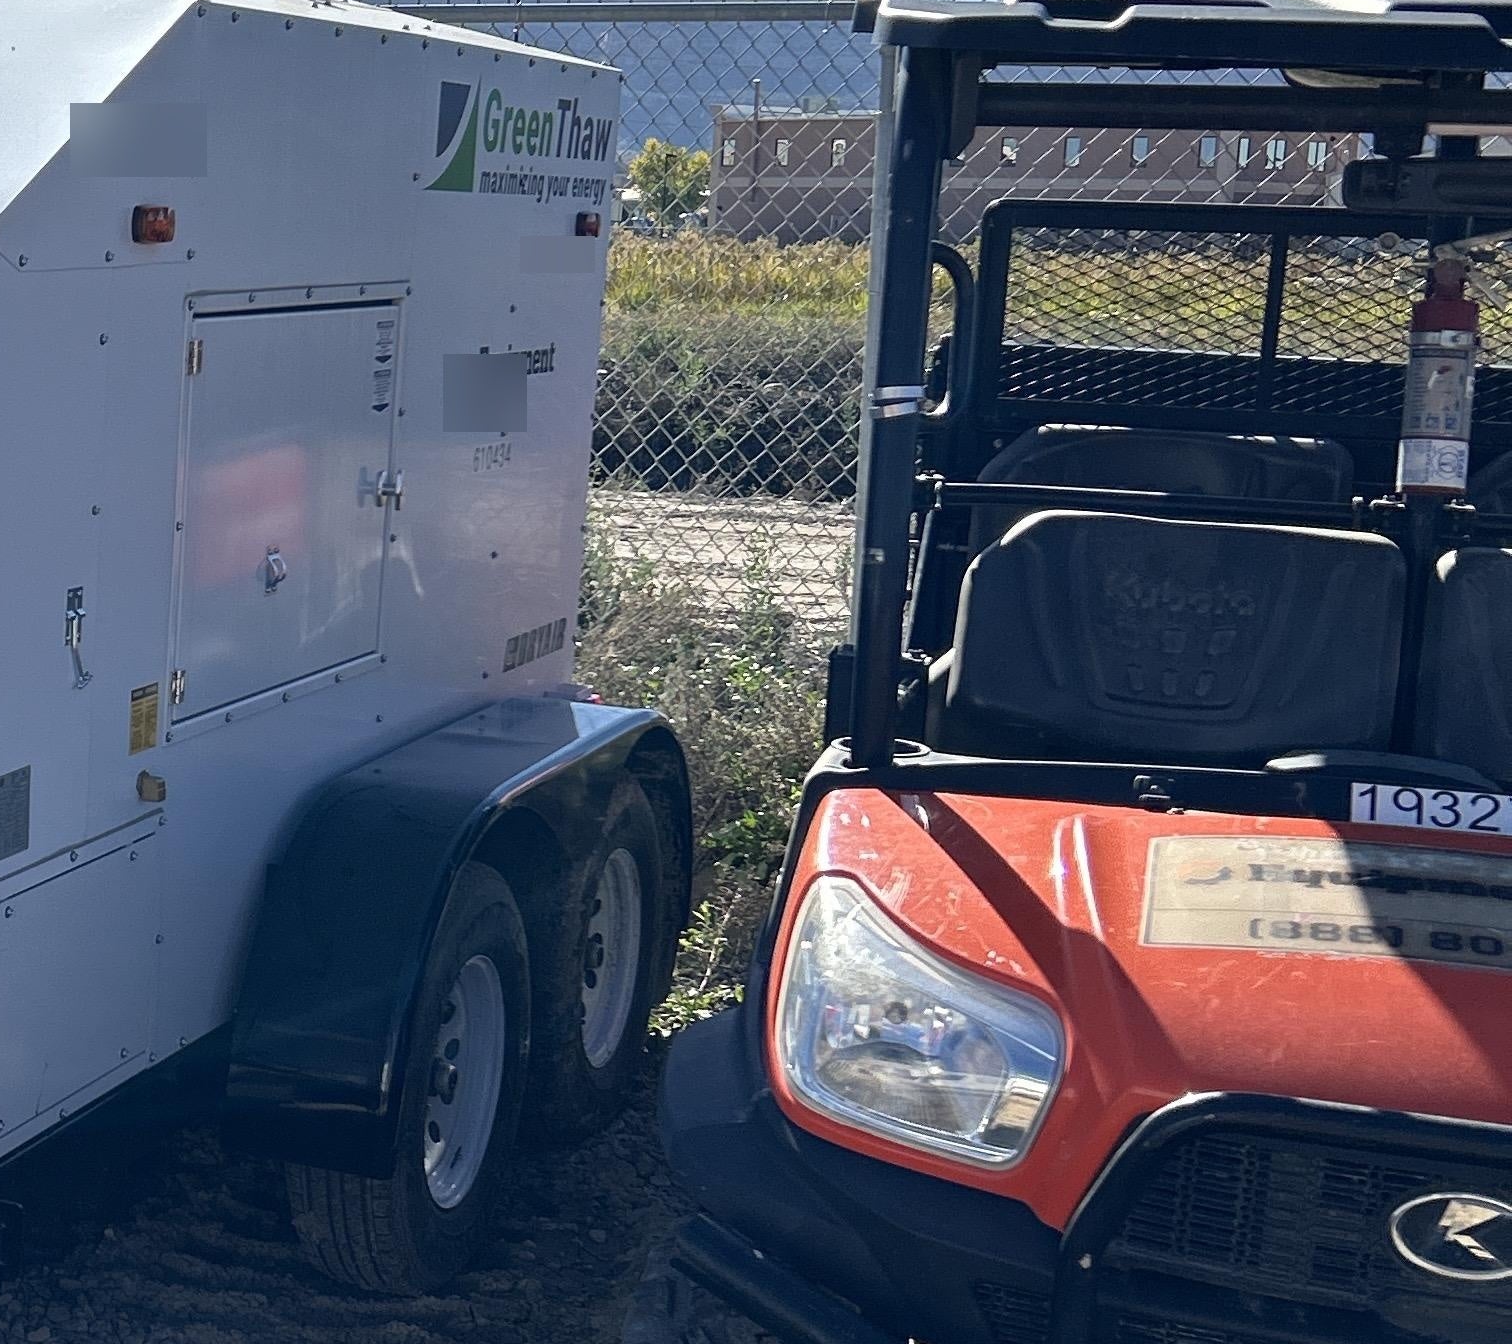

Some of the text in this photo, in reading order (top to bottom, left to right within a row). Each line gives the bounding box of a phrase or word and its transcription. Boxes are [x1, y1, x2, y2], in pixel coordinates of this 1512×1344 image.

[478, 164, 607, 206] maximizing your energy
[1358, 784, 1512, 833] 1932
[1247, 916, 1404, 949] (888)
